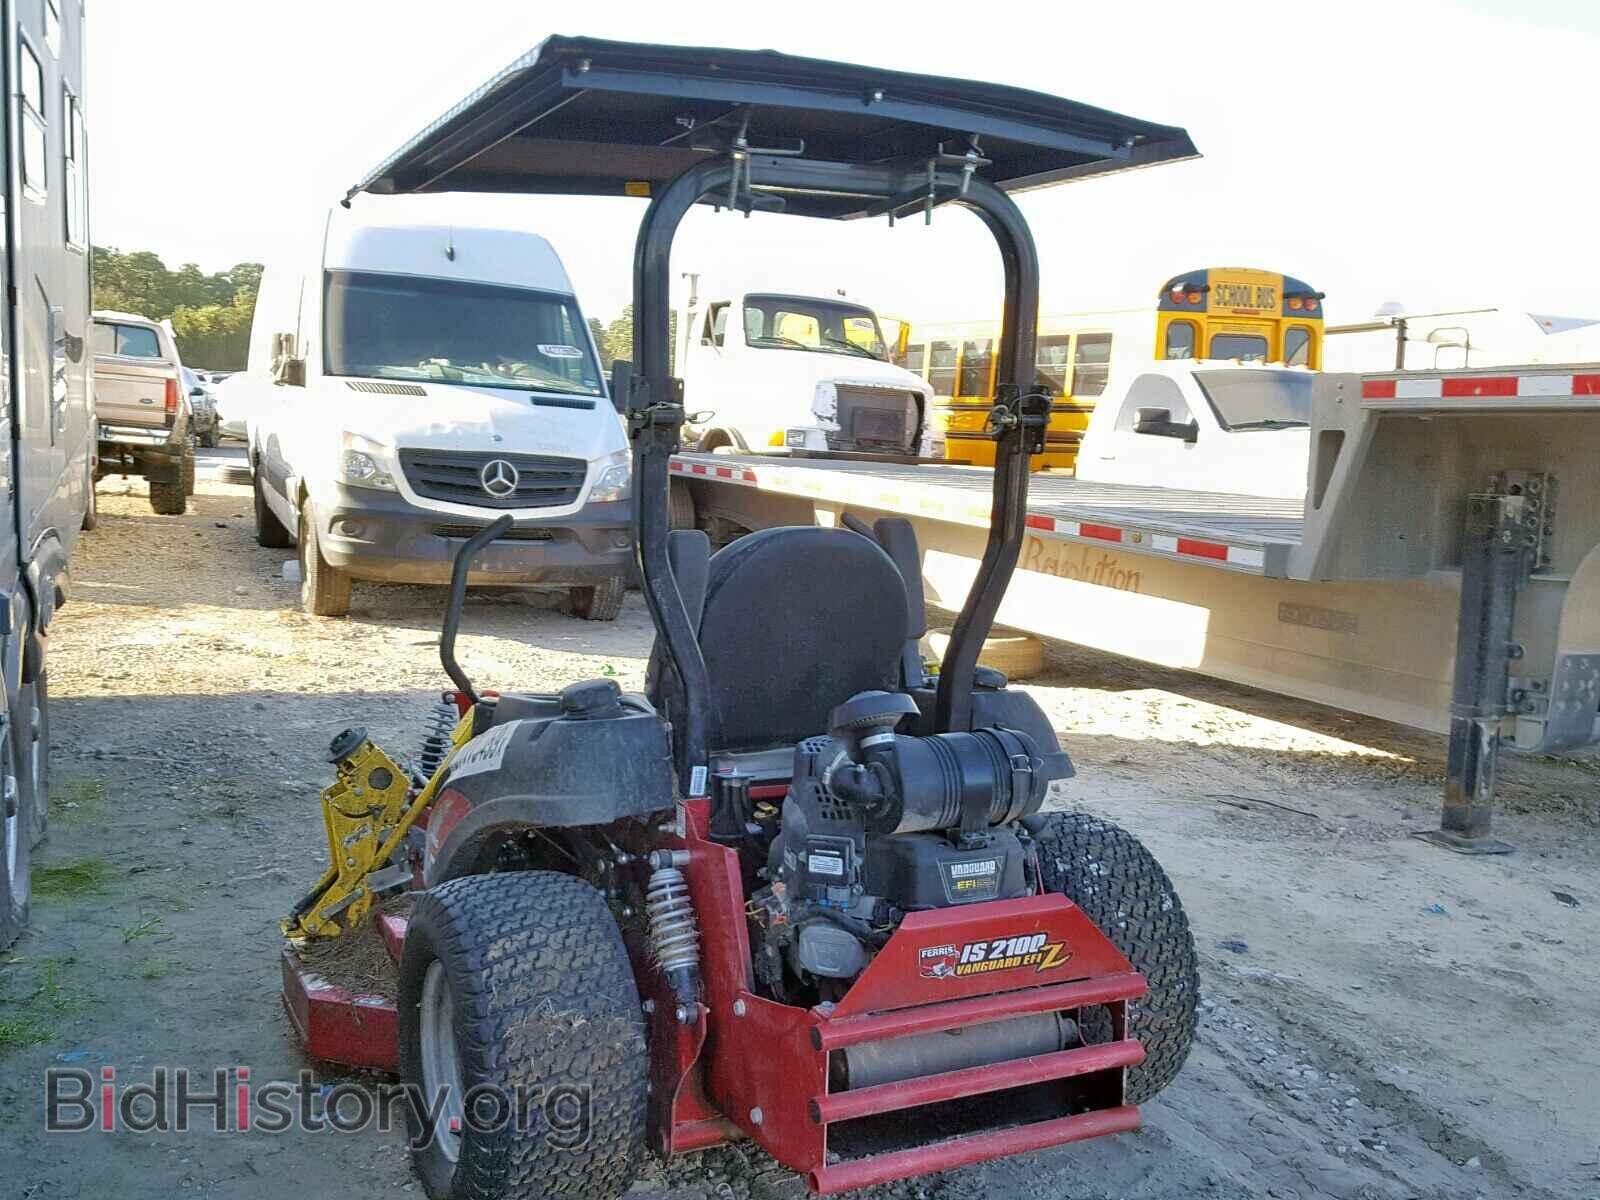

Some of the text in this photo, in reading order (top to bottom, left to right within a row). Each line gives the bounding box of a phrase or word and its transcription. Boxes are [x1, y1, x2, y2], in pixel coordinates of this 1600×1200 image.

[1215, 284, 1276, 308] SCHOOL BUS
[951, 860, 996, 877] VANGUARD
[957, 880, 976, 889] EFI
[920, 946, 955, 958] FERRIS
[960, 943, 988, 963] IS
[989, 933, 1047, 960] 2100
[956, 954, 1042, 976] VANGUARD EFI
